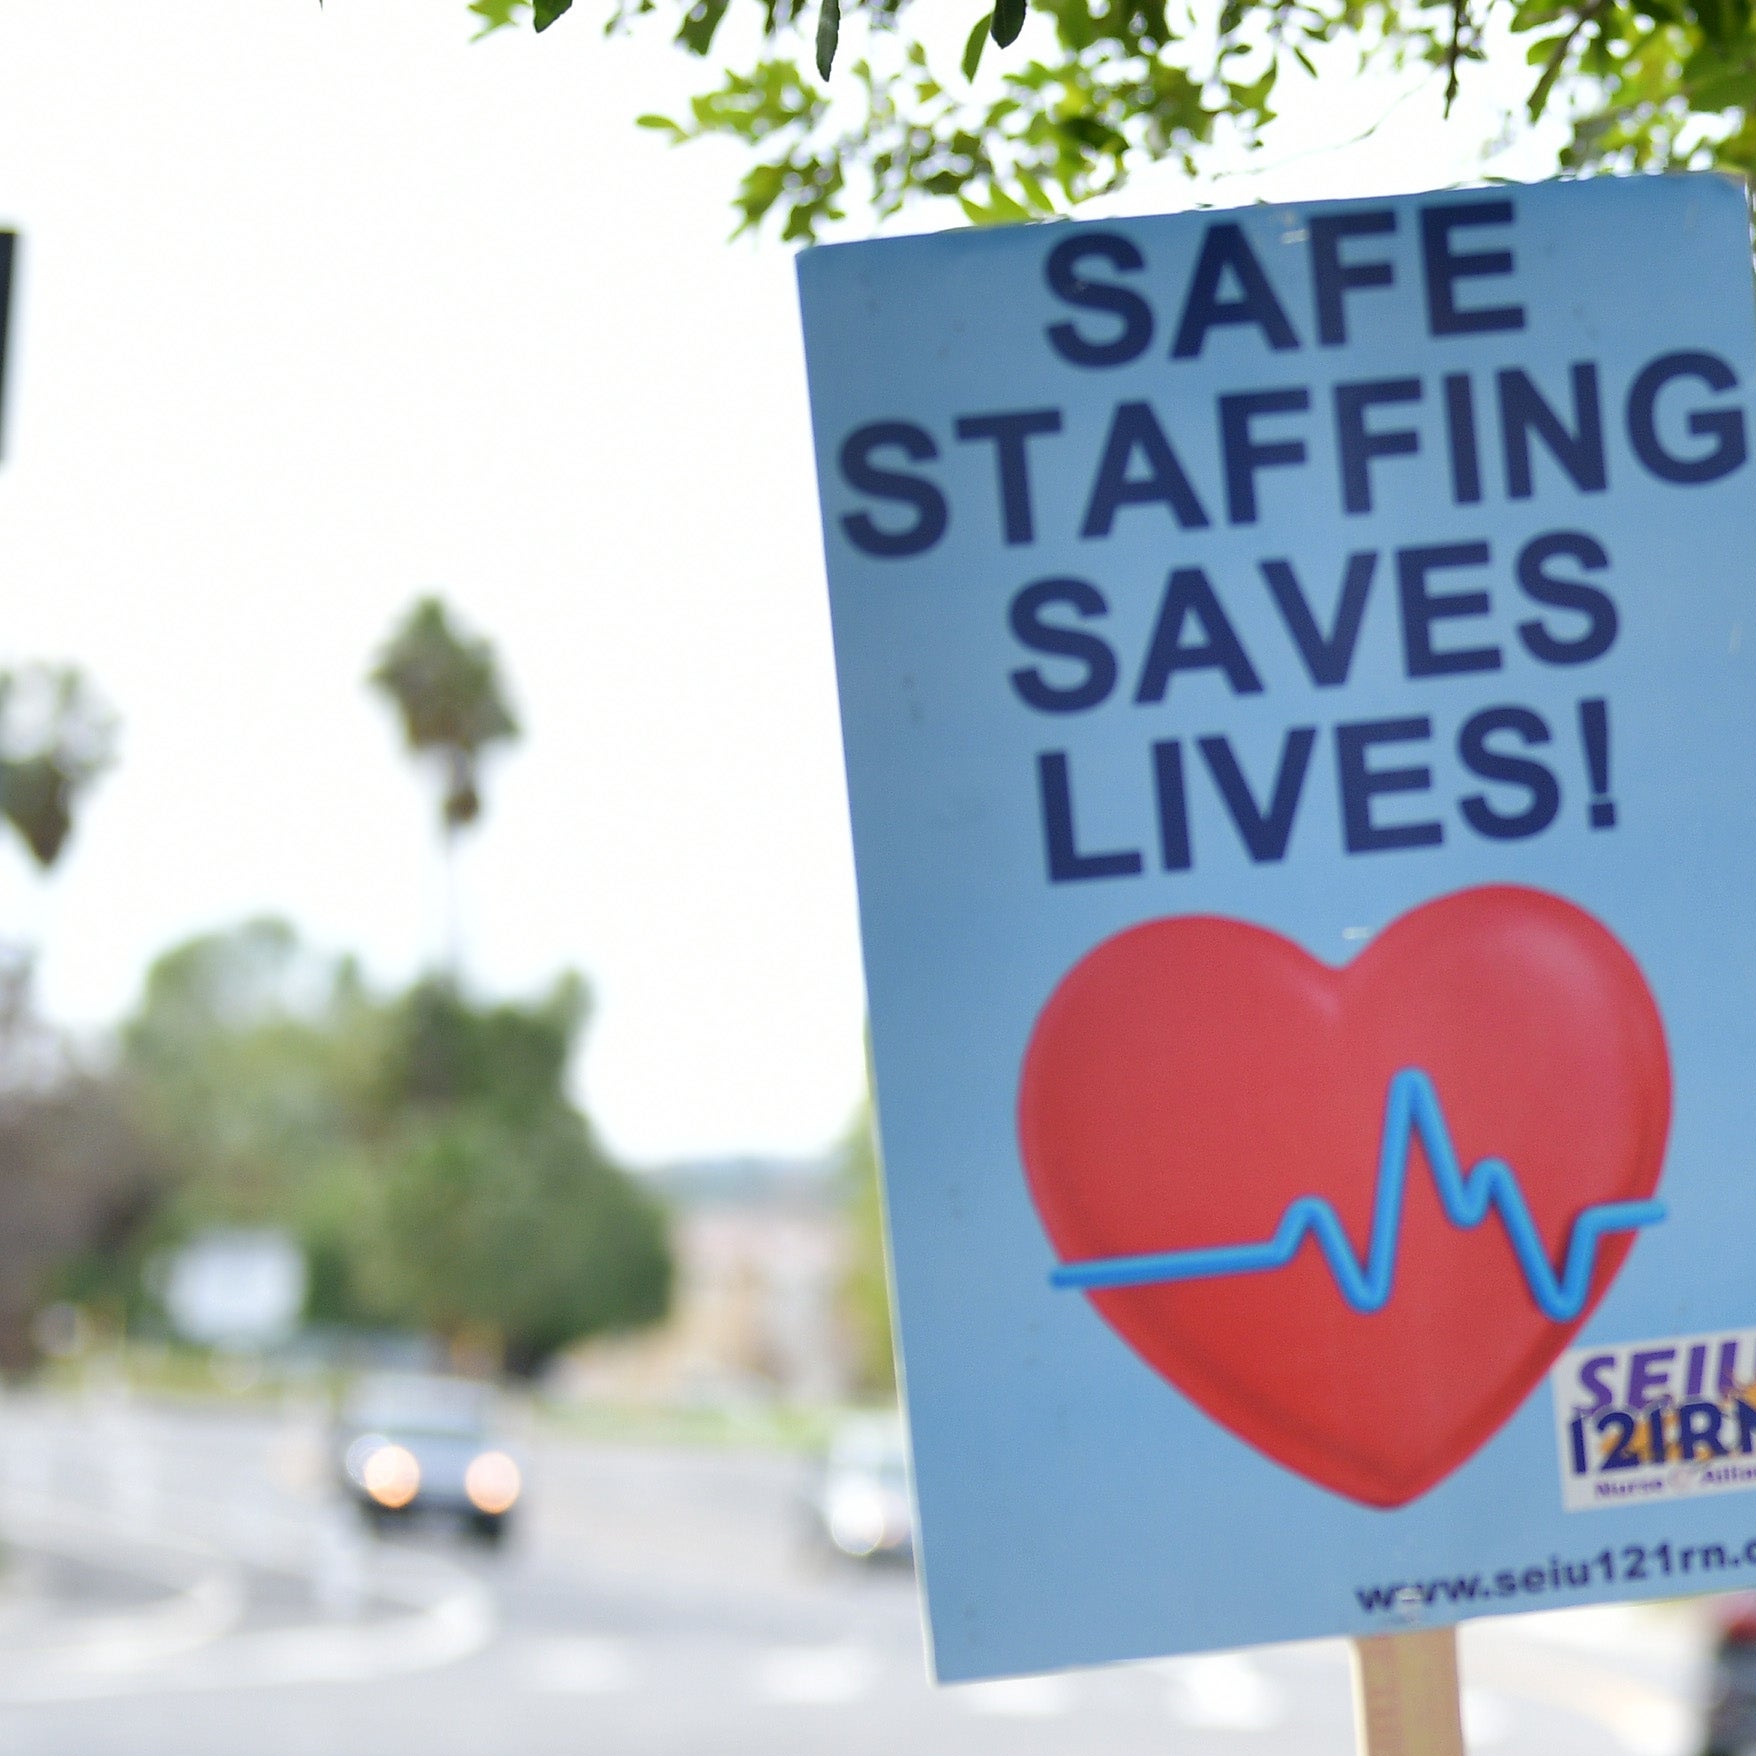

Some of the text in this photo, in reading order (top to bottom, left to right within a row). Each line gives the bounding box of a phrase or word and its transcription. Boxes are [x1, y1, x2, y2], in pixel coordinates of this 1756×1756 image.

[1043, 200, 1527, 370] SAFE
[838, 349, 1749, 561] STAFFING
[1008, 531, 1620, 715] SAVES
[1038, 696, 1617, 885] LIVES!
